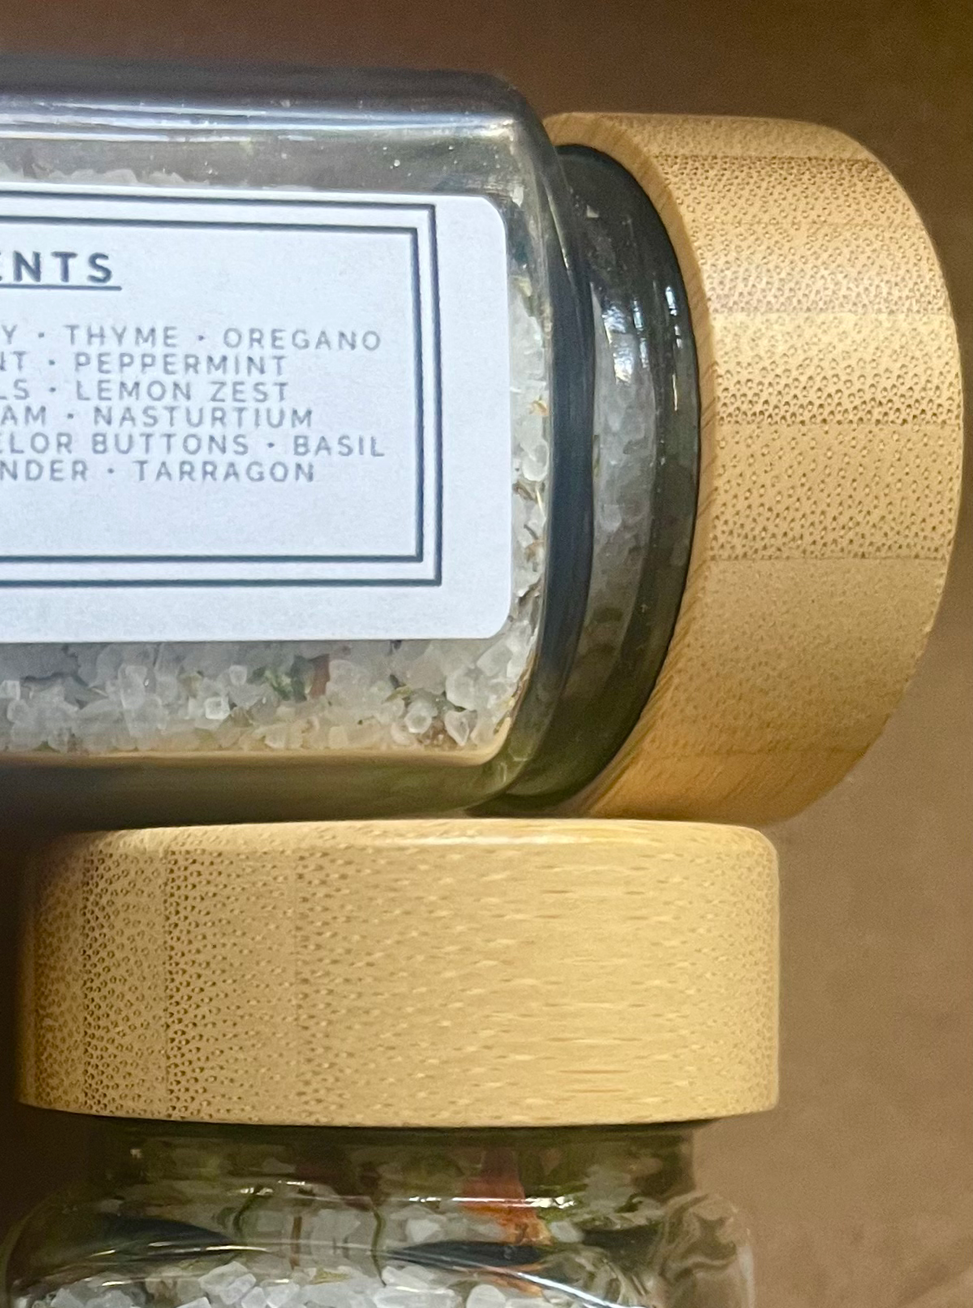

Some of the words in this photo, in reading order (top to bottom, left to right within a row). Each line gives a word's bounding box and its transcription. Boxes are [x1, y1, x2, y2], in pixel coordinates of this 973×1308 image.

[64, 324, 178, 347] THYME
[223, 327, 381, 351] OREGANO
[75, 352, 287, 376] PEPPERMINT
[76, 380, 192, 401] LEMON
[210, 381, 289, 402] ZEST
[93, 406, 313, 428] NASTURTIUM
[92, 434, 249, 455] BUTTONS
[293, 435, 385, 458] BASIL
[132, 460, 314, 482] TARRAGON
